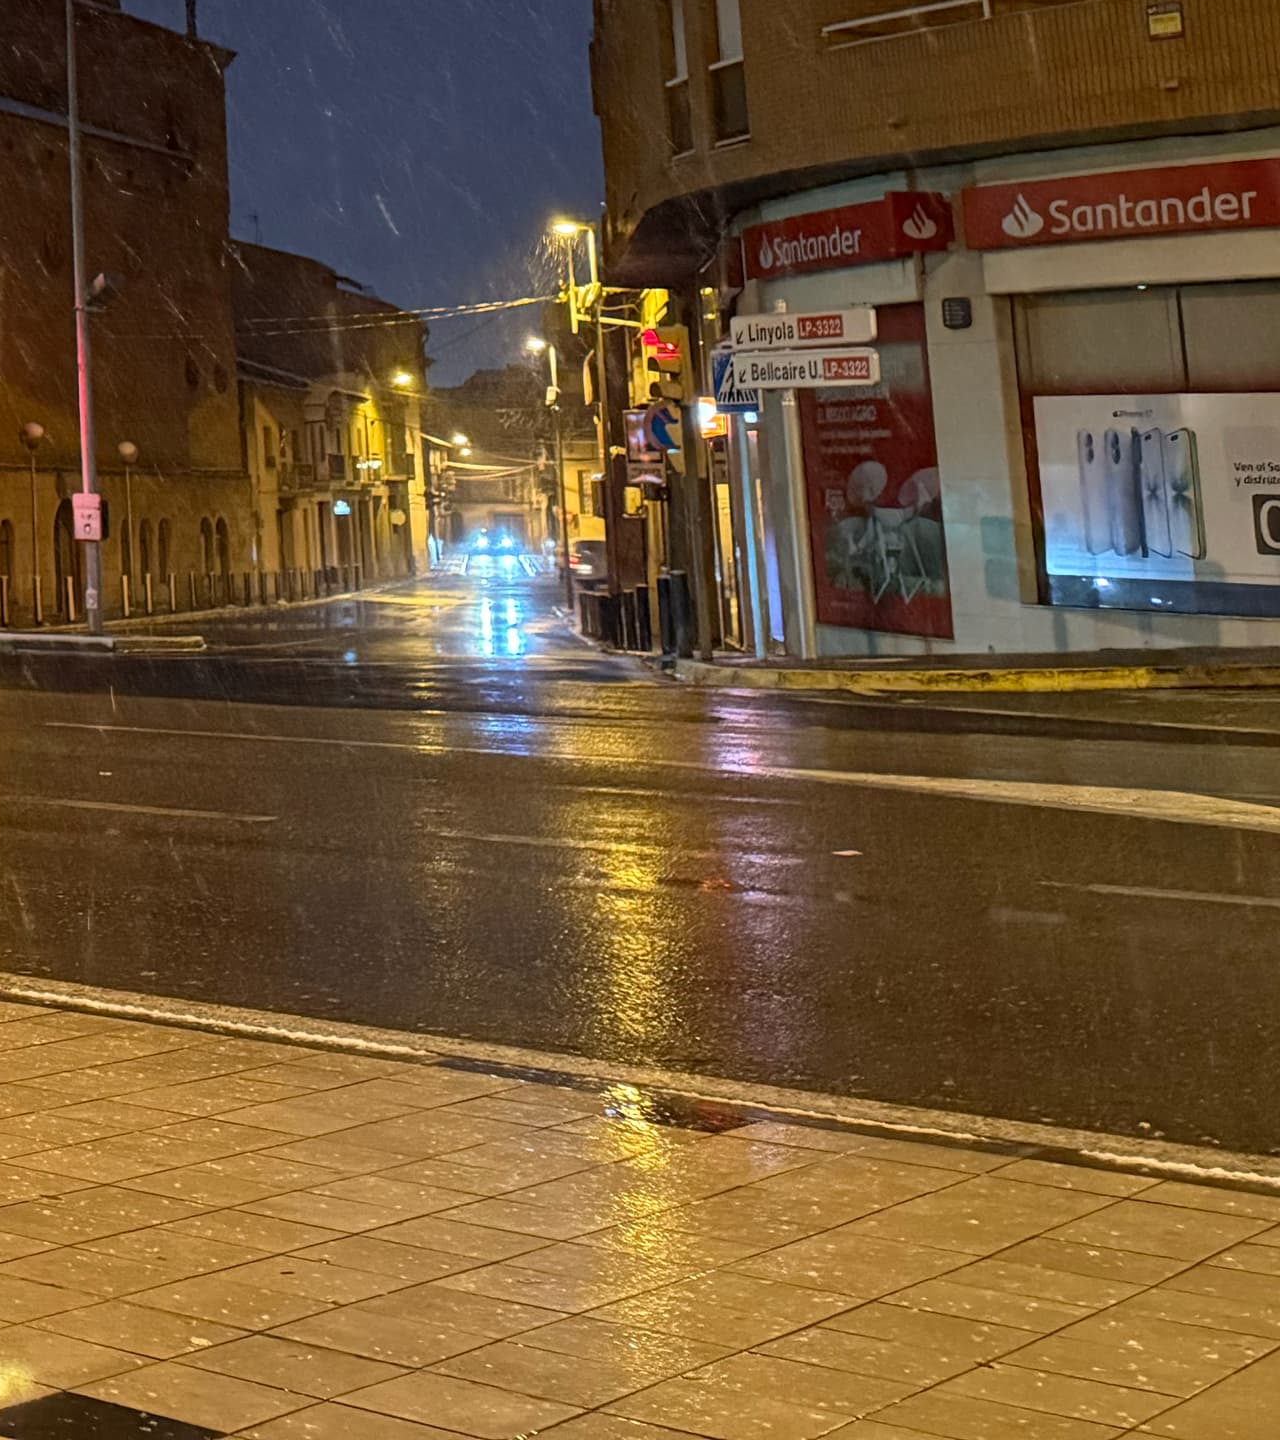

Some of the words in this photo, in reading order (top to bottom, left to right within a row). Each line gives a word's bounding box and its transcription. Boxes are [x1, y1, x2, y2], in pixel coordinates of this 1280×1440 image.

[1049, 187, 1257, 234] Santander
[773, 224, 862, 266] Santander
[748, 322, 794, 344] Linyola
[799, 319, 841, 337] LP-3322
[751, 363, 806, 381] Bellcaire
[808, 361, 822, 379] U.
[824, 361, 868, 378] LP-3322
[1233, 462, 1254, 472] Ven
[1234, 477, 1241, 487] y
